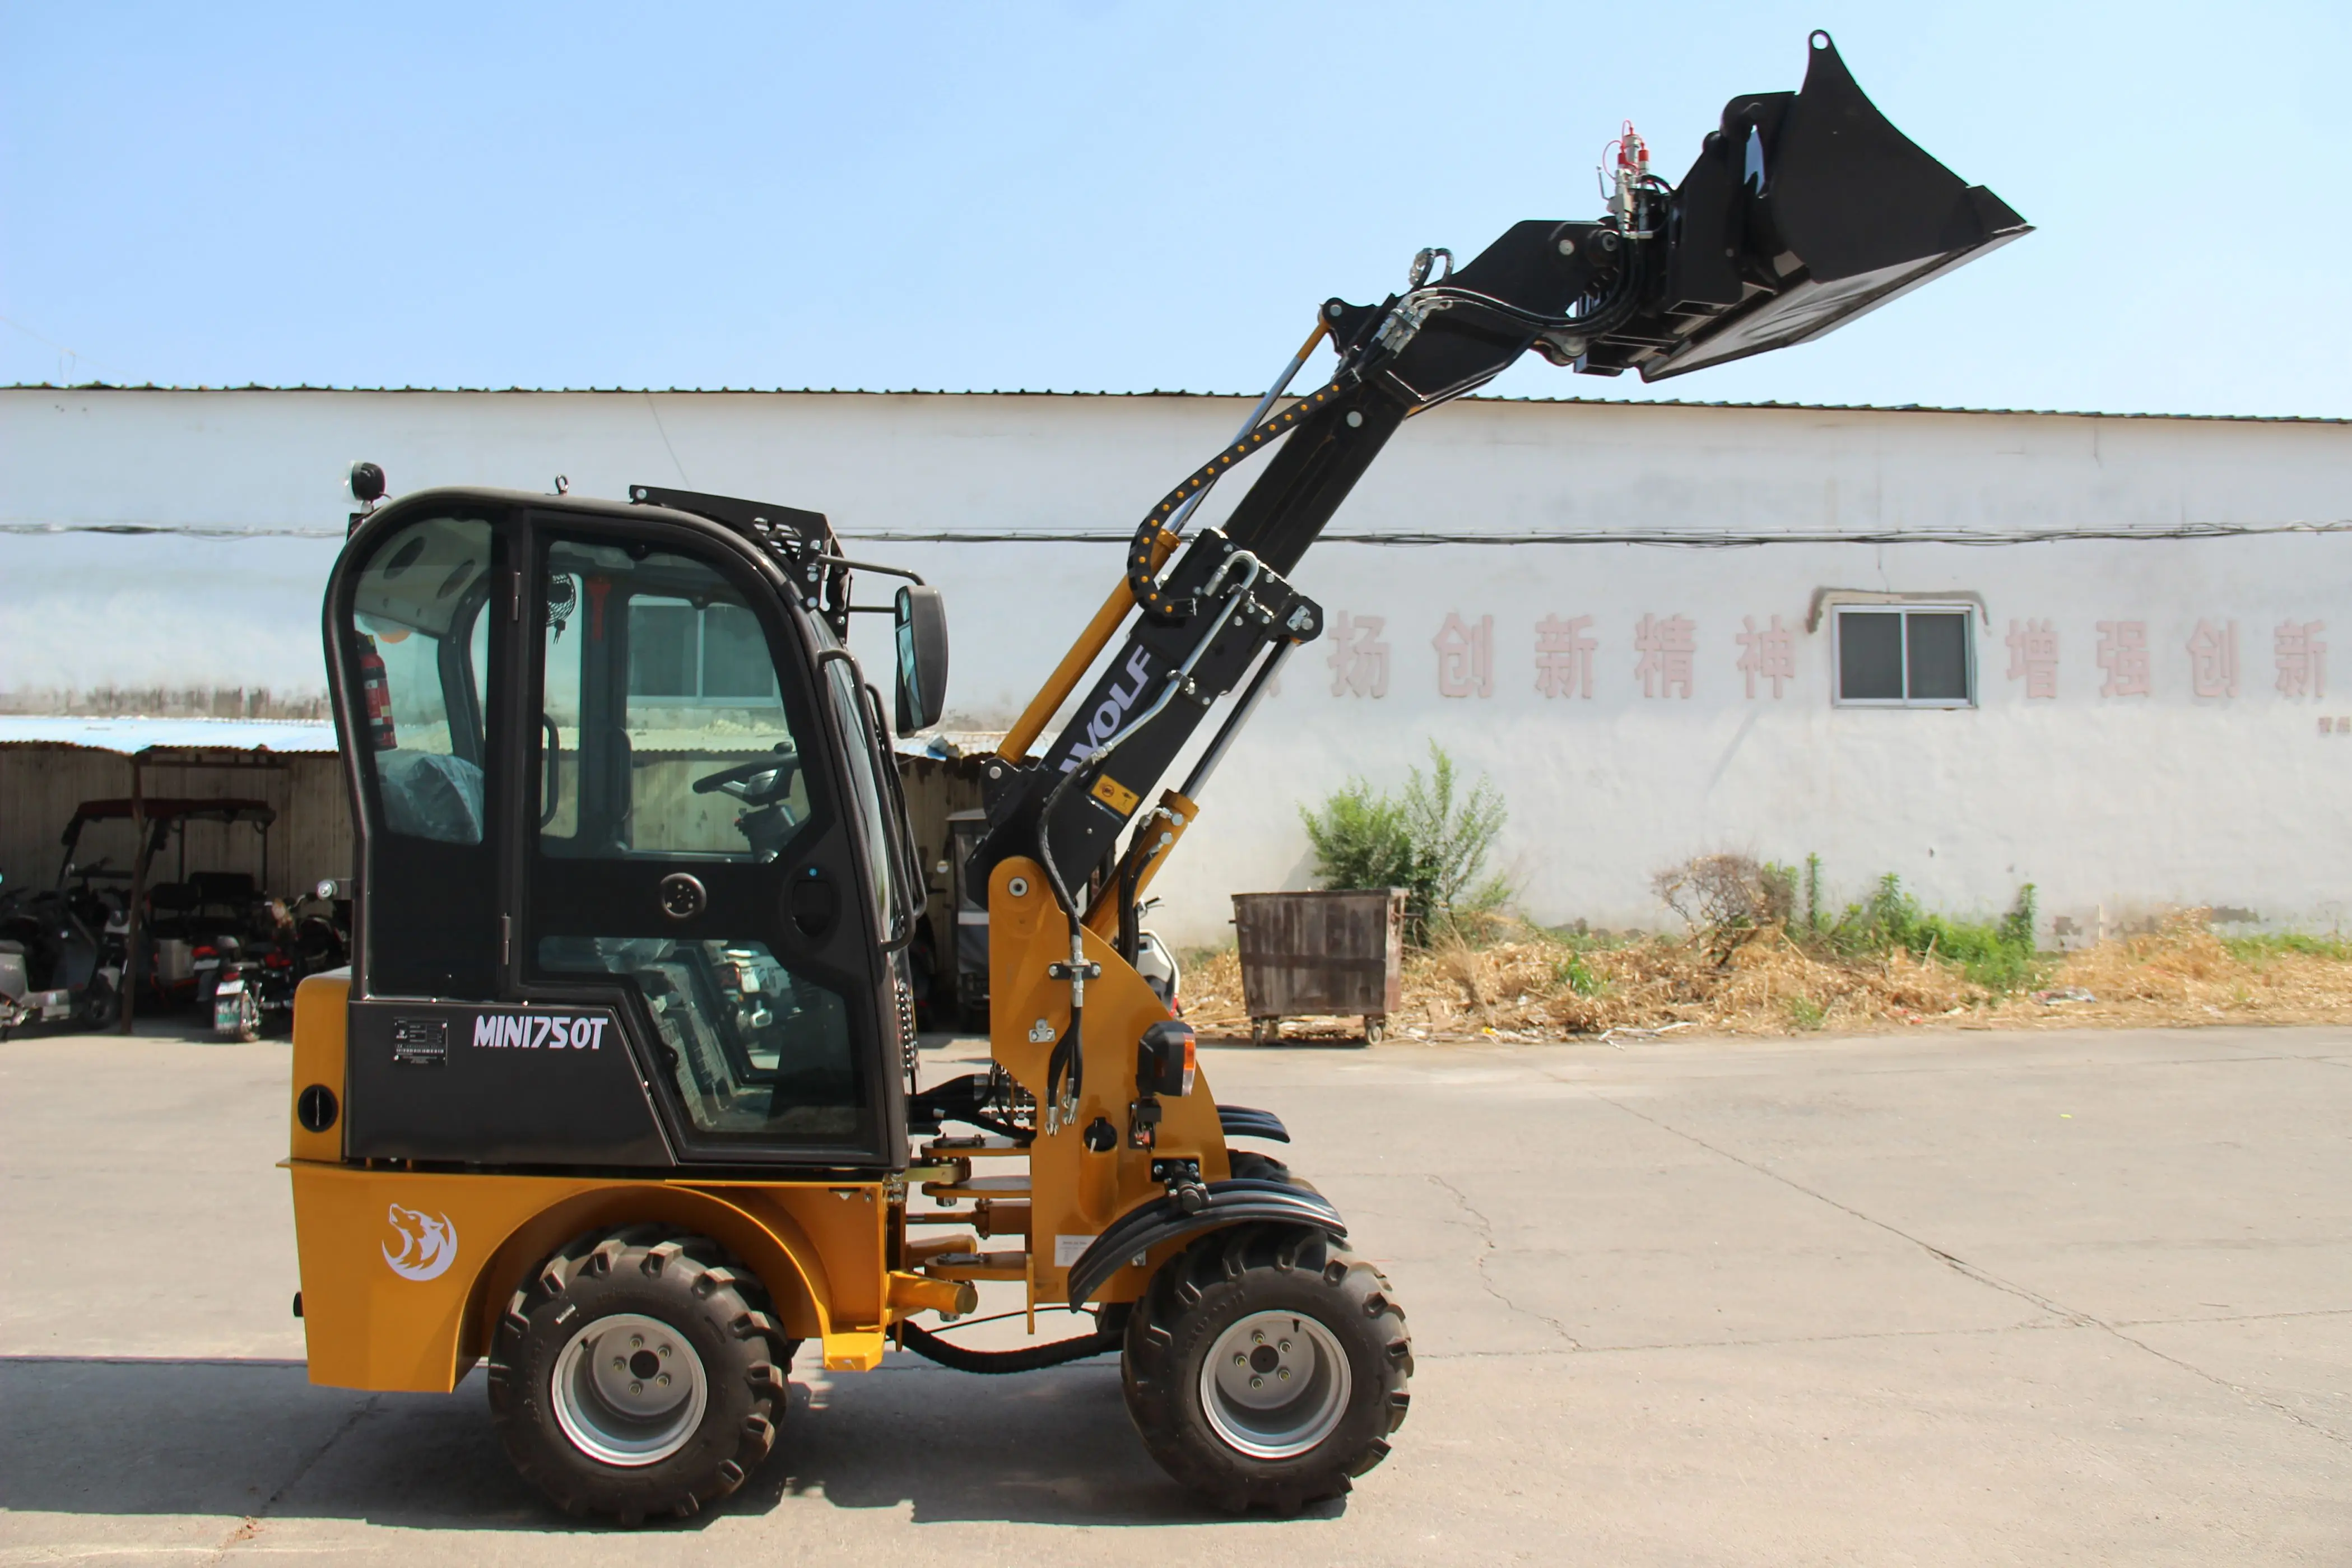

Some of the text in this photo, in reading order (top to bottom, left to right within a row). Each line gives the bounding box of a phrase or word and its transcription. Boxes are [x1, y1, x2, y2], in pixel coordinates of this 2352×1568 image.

[1223, 610, 1795, 699] 扬创新精神
[2005, 618, 2327, 699] 增强创新
[473, 1015, 608, 1049] MINI750T
